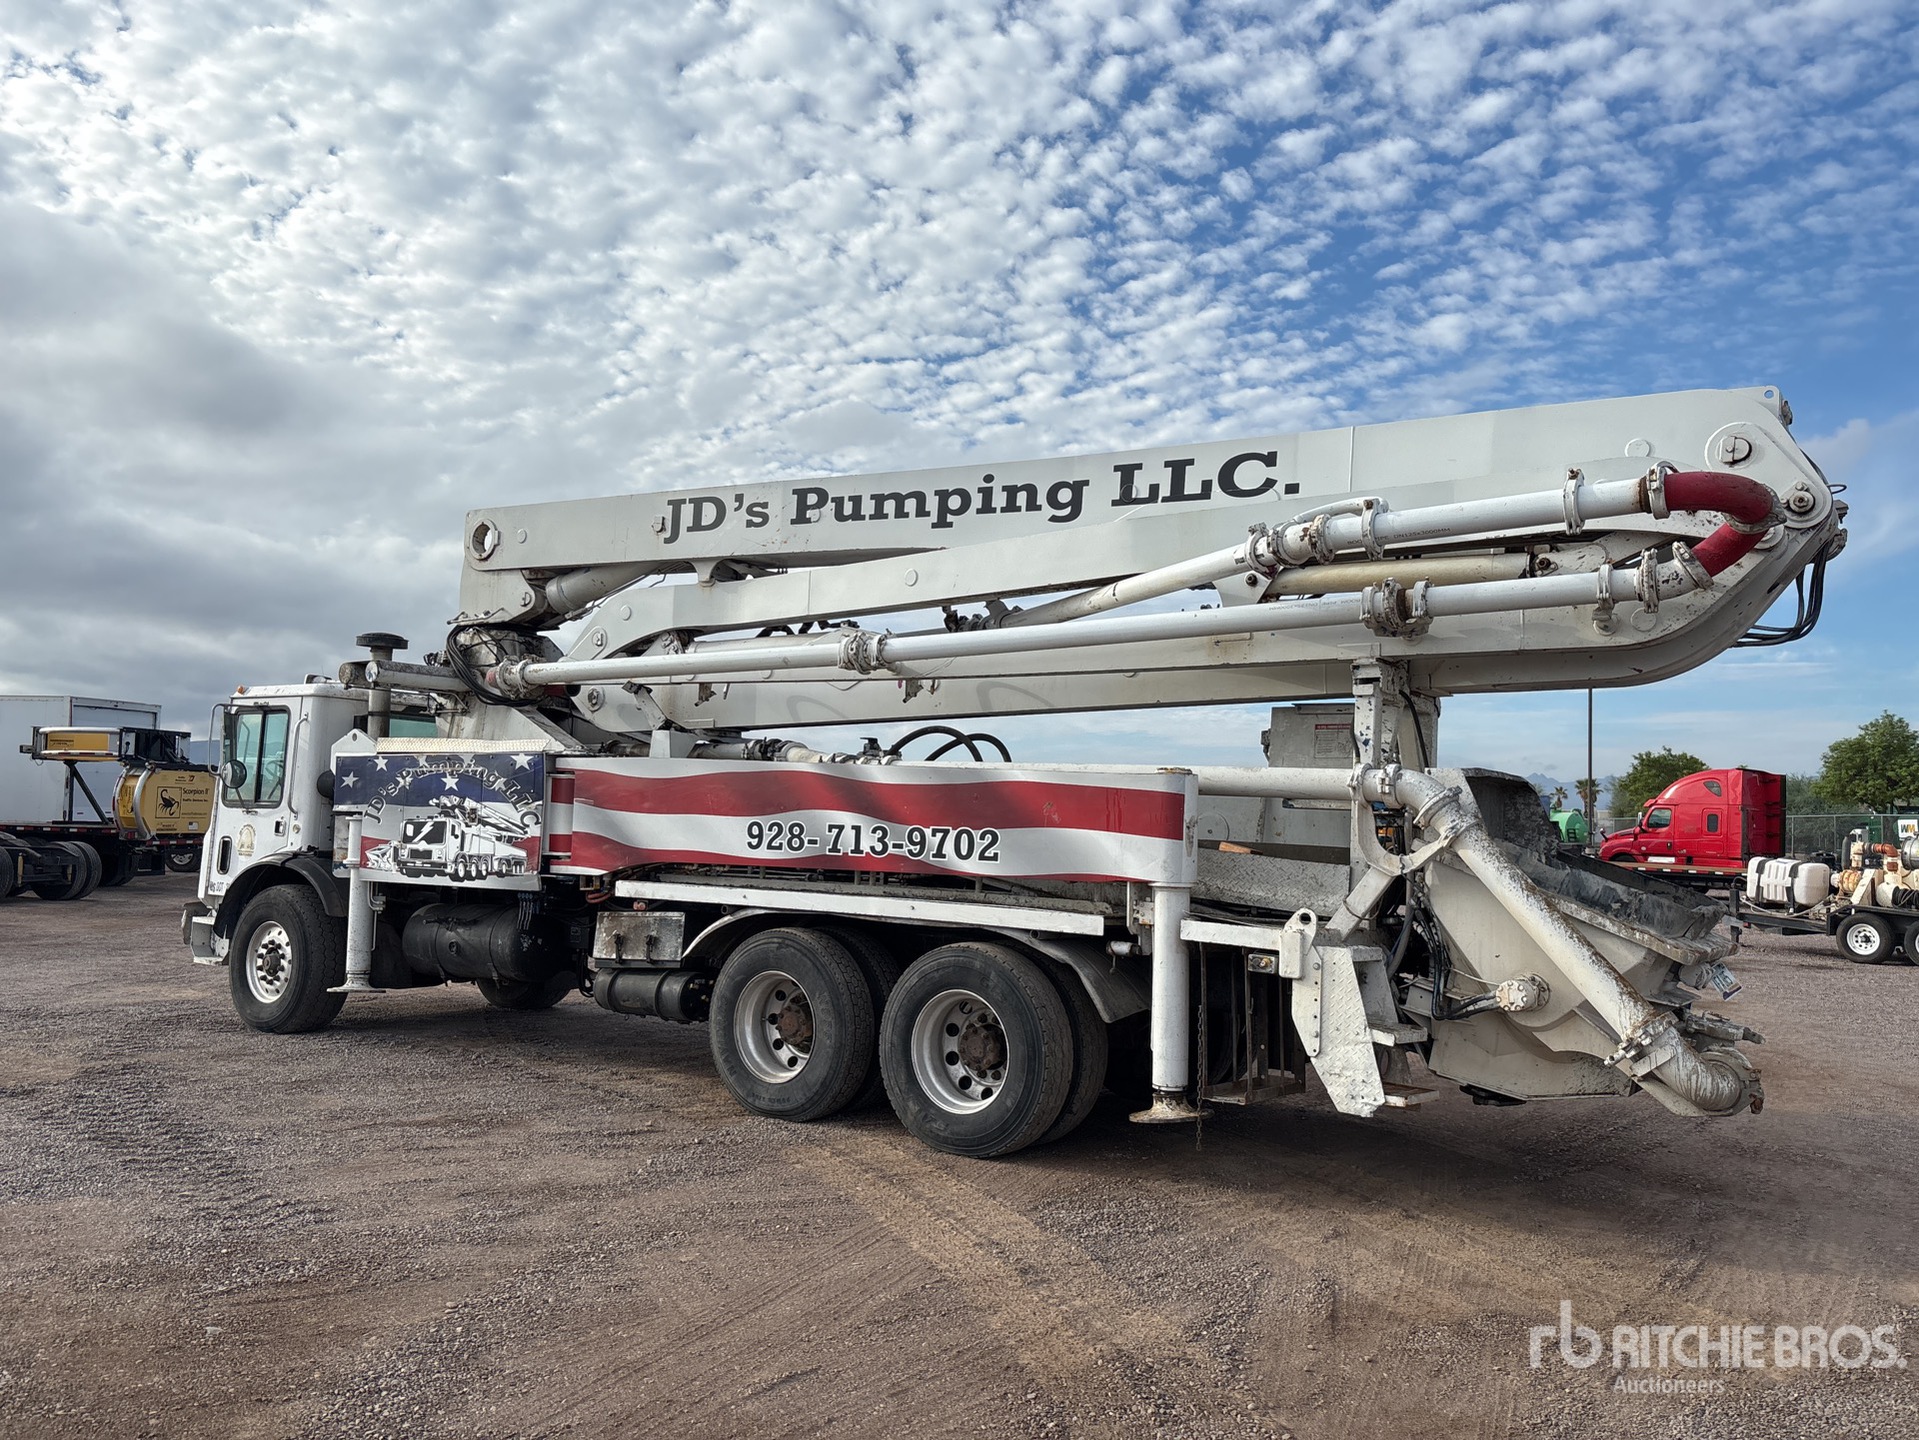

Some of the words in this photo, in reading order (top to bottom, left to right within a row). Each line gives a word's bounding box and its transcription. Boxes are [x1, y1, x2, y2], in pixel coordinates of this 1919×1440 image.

[663, 494, 770, 544] JD's
[790, 473, 1089, 530] Pumping
[1111, 450, 1301, 507] LLC.
[183, 787, 205, 796] Scorpion
[364, 784, 399, 824] JD's
[398, 759, 500, 788] Pumping
[500, 781, 542, 830] LLC
[746, 820, 1001, 863] 928-713-9702
